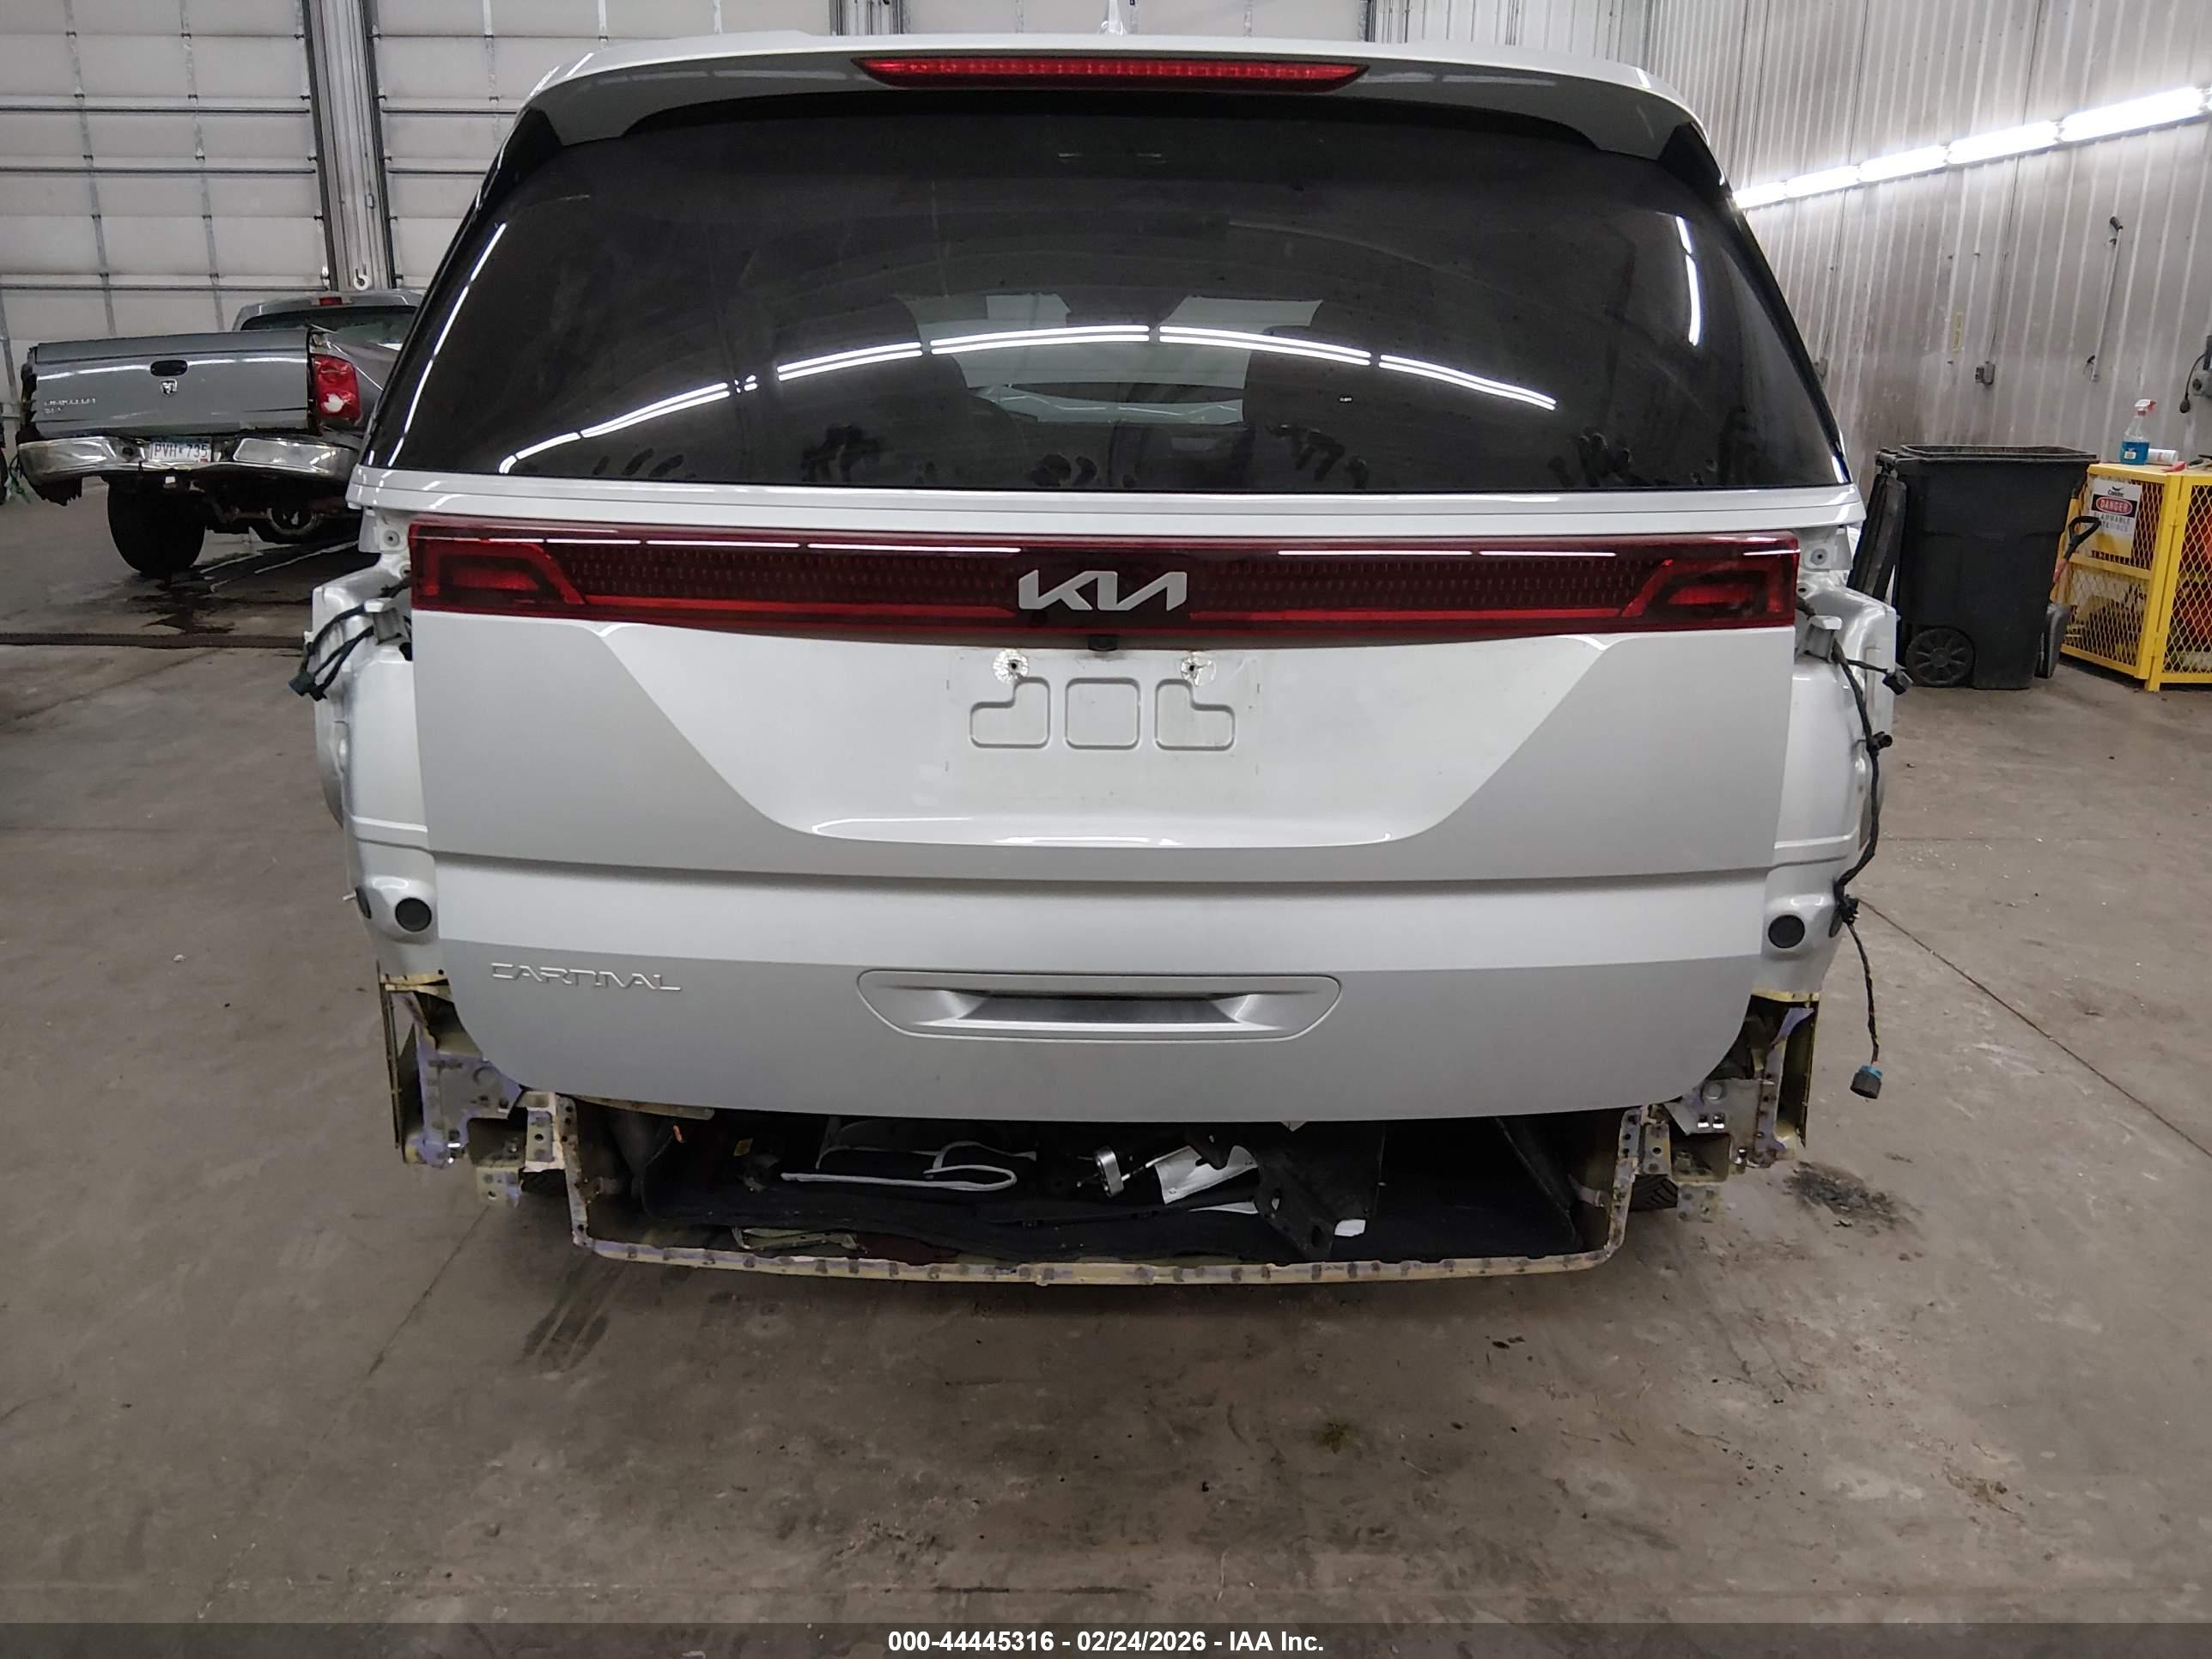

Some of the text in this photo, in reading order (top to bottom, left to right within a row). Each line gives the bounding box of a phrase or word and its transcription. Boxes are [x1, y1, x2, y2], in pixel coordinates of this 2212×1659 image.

[185, 443, 208, 458] 735
[2100, 500, 2129, 512] DANGER
[1018, 568, 1188, 611] KIA
